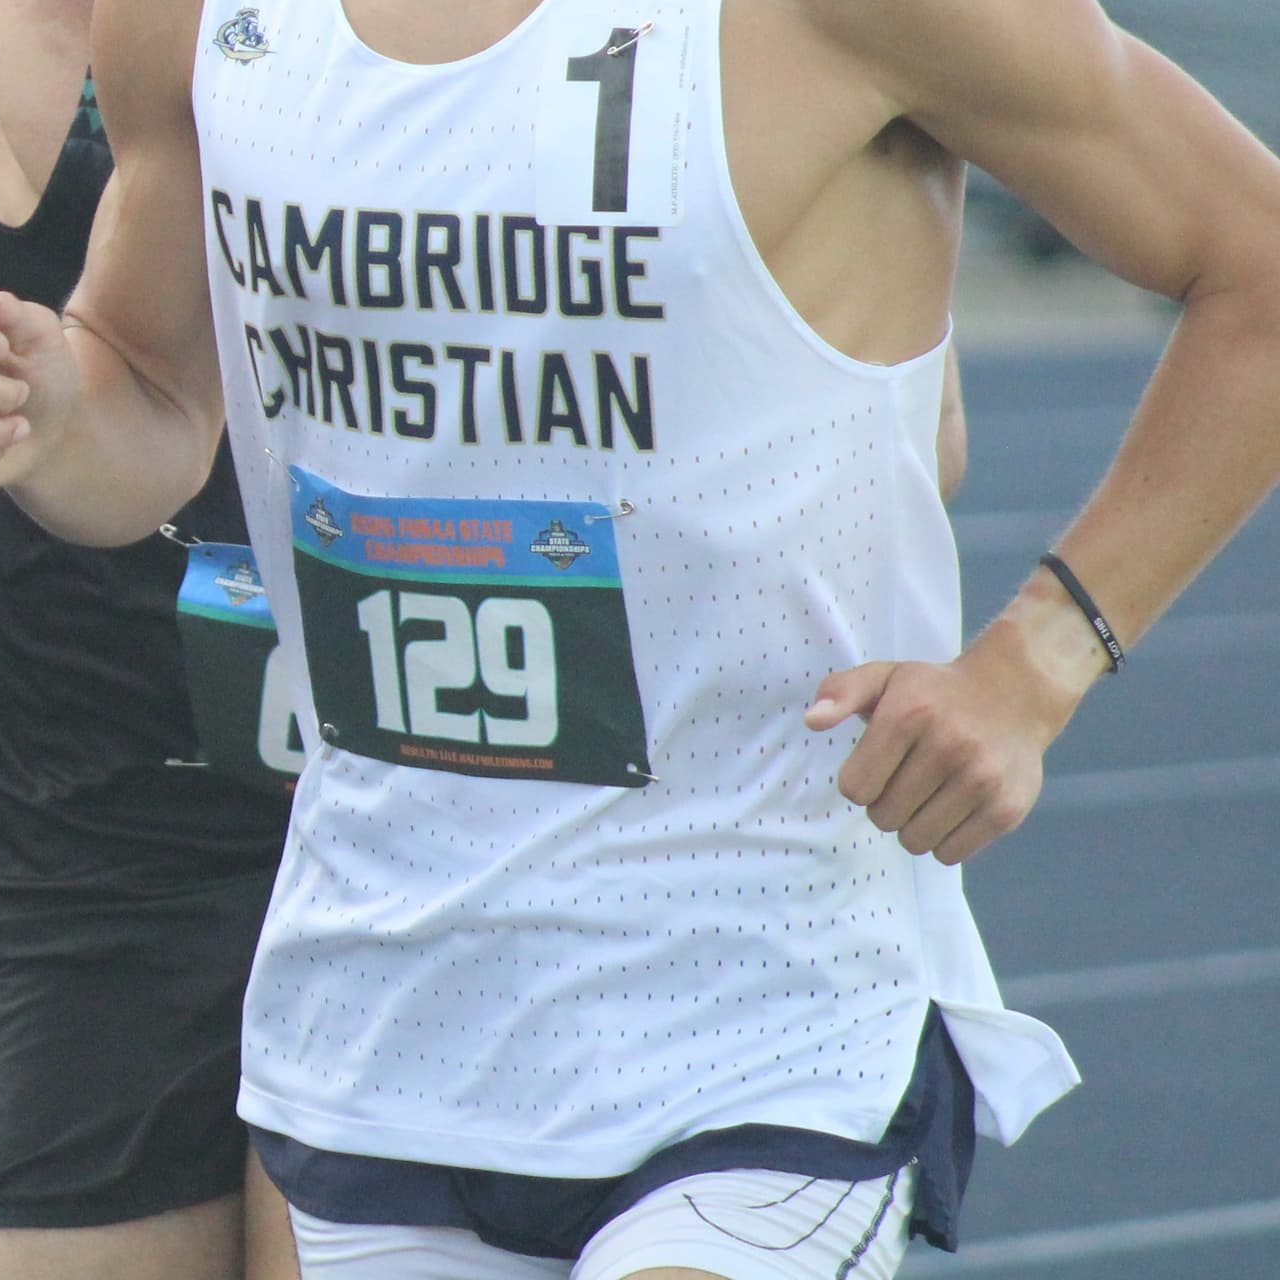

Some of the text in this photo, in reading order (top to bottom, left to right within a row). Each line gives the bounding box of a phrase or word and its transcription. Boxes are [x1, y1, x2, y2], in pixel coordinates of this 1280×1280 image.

[566, 26, 637, 213] 1
[210, 187, 667, 321] CAMBRIDGE
[244, 320, 657, 452] CHRISTIAN
[365, 540, 506, 568] CHAMPIONSHIPS
[459, 519, 513, 543] STATE
[530, 544, 590, 553] CHAMPIONSHIPS
[356, 589, 560, 747] 129
